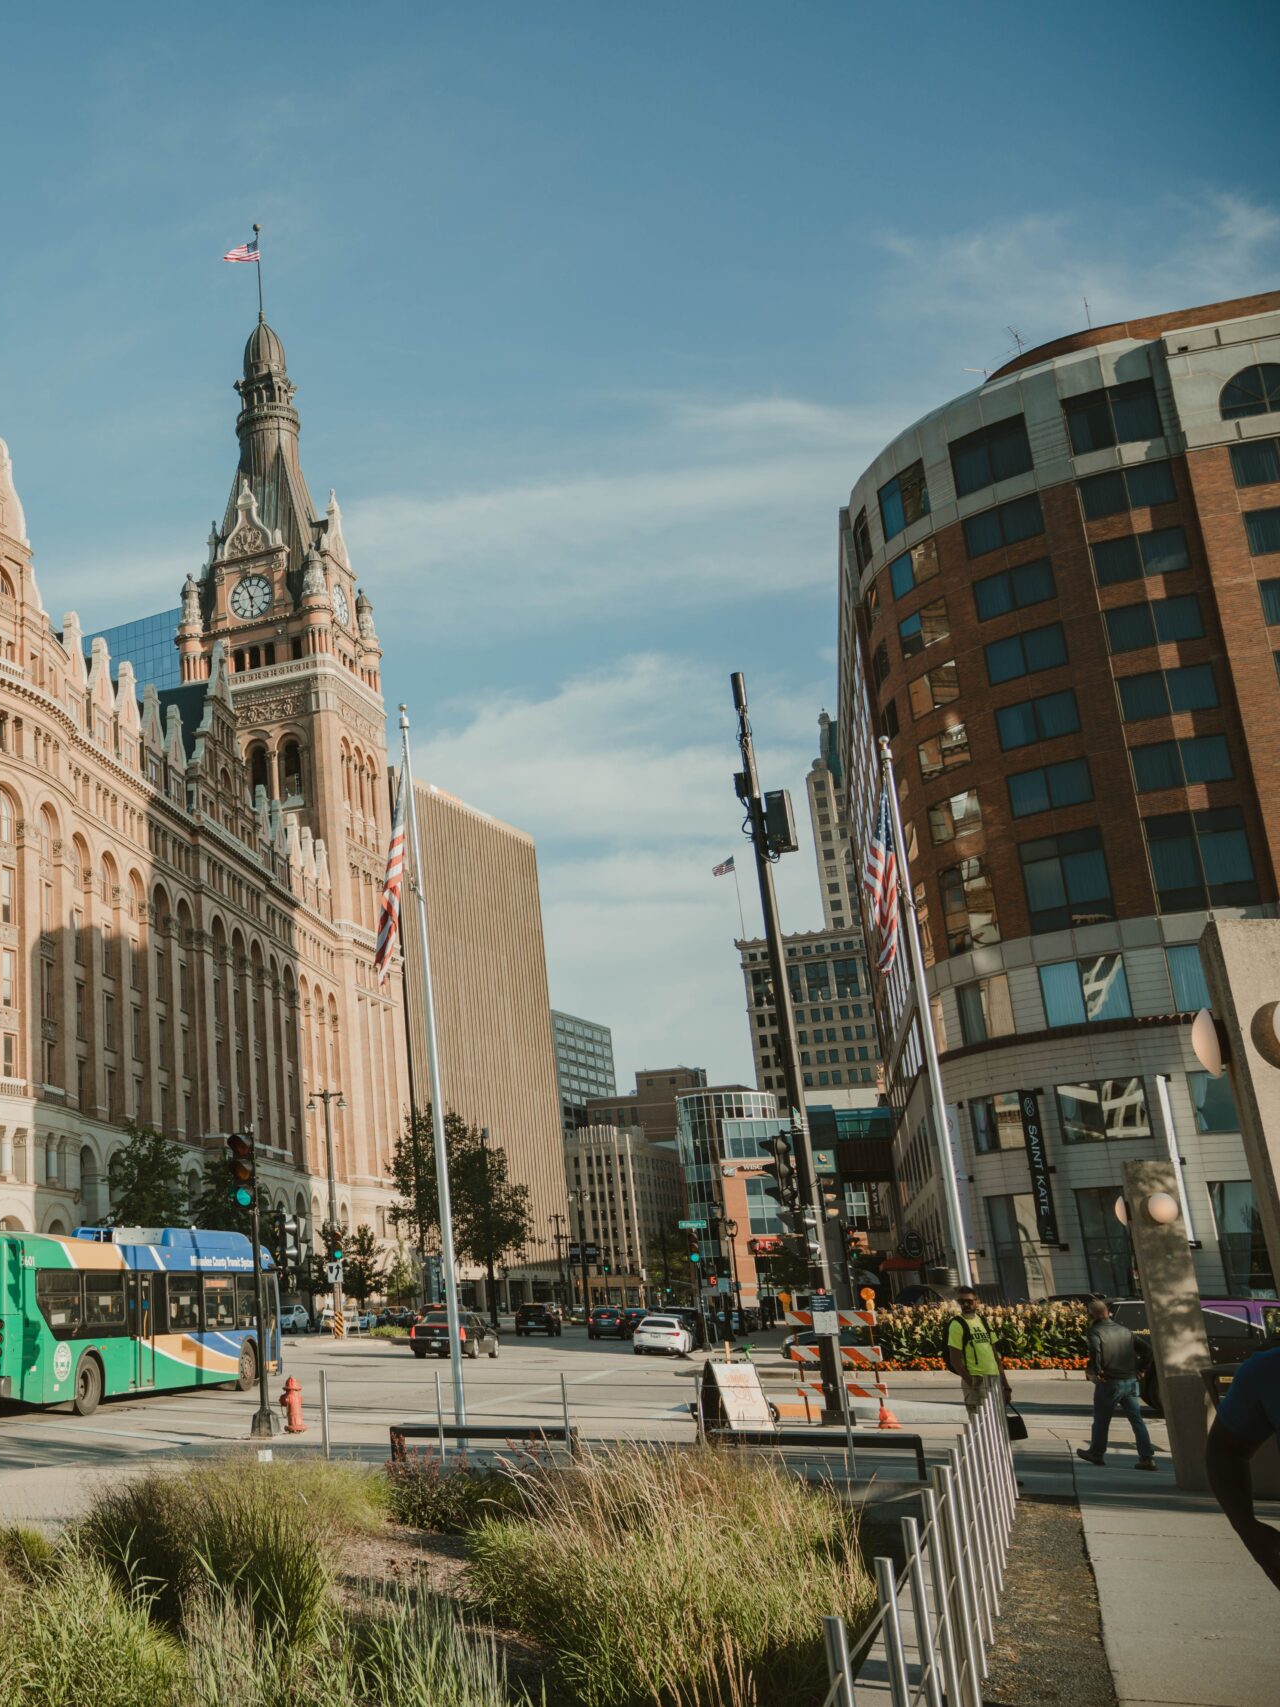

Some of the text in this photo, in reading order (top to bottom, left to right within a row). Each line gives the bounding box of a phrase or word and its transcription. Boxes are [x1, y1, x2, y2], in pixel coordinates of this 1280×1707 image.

[1028, 1125, 1044, 1171] SAINT
[1036, 1175, 1050, 1216] KATE
[212, 1255, 227, 1270] County
